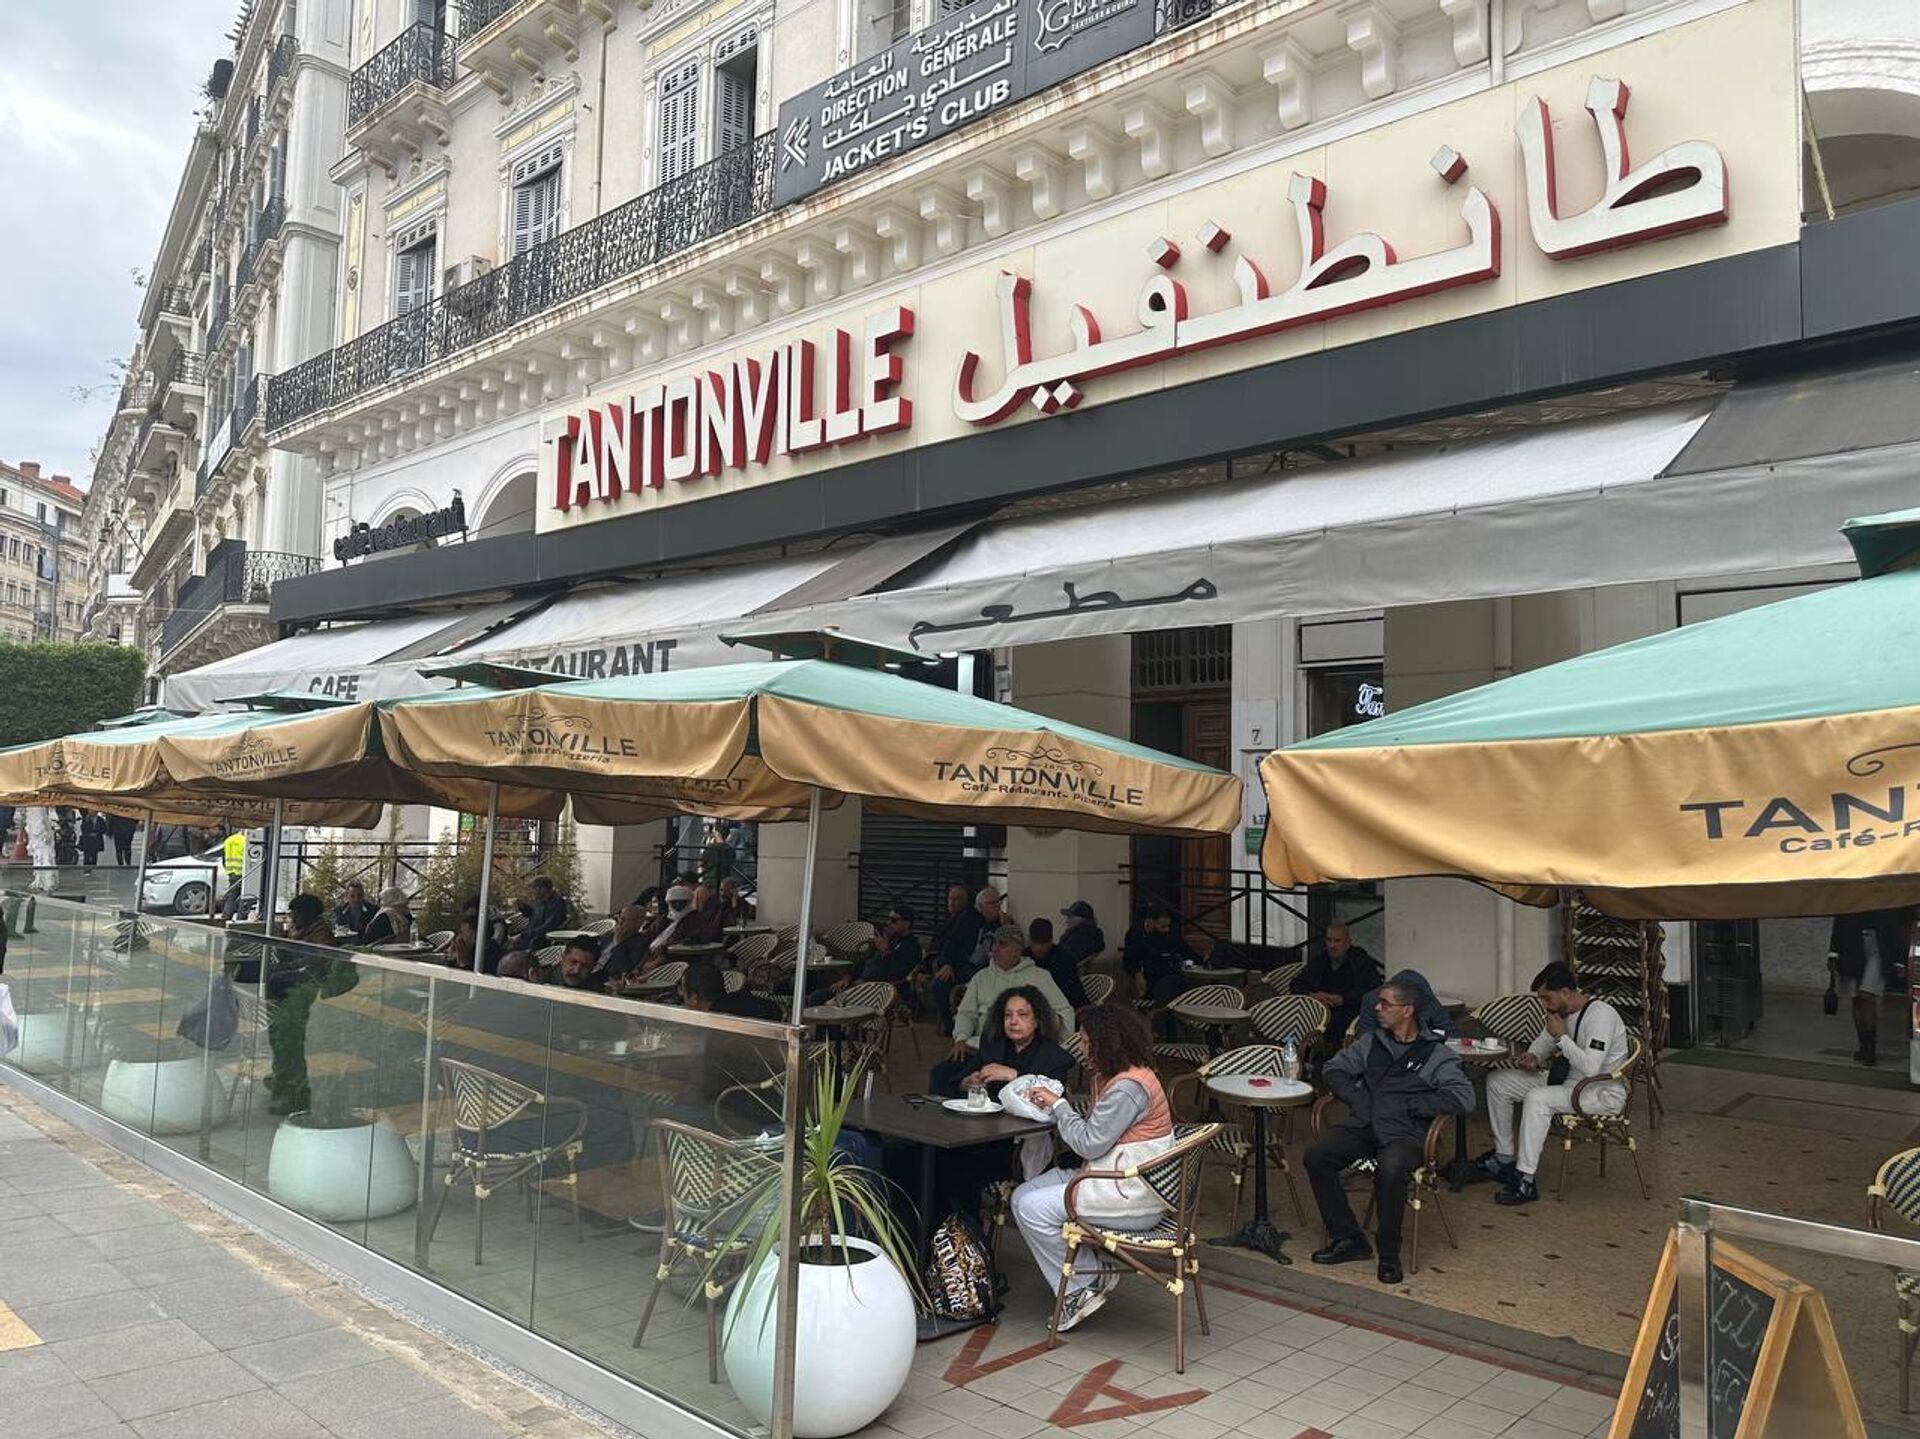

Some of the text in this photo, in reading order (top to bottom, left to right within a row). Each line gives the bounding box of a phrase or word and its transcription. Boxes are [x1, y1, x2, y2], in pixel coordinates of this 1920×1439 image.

[821, 13, 1018, 127] DIRECTION GENERALE
[823, 51, 894, 98] العامة
[920, 42, 1013, 114] نادي
[820, 79, 1010, 182] JACKET'S CLUB
[542, 305, 914, 512] TANTONVILLE
[485, 728, 638, 757] TANONVILLE
[933, 761, 1144, 806] TANTONVILLE
[1680, 783, 1920, 839] TAN
